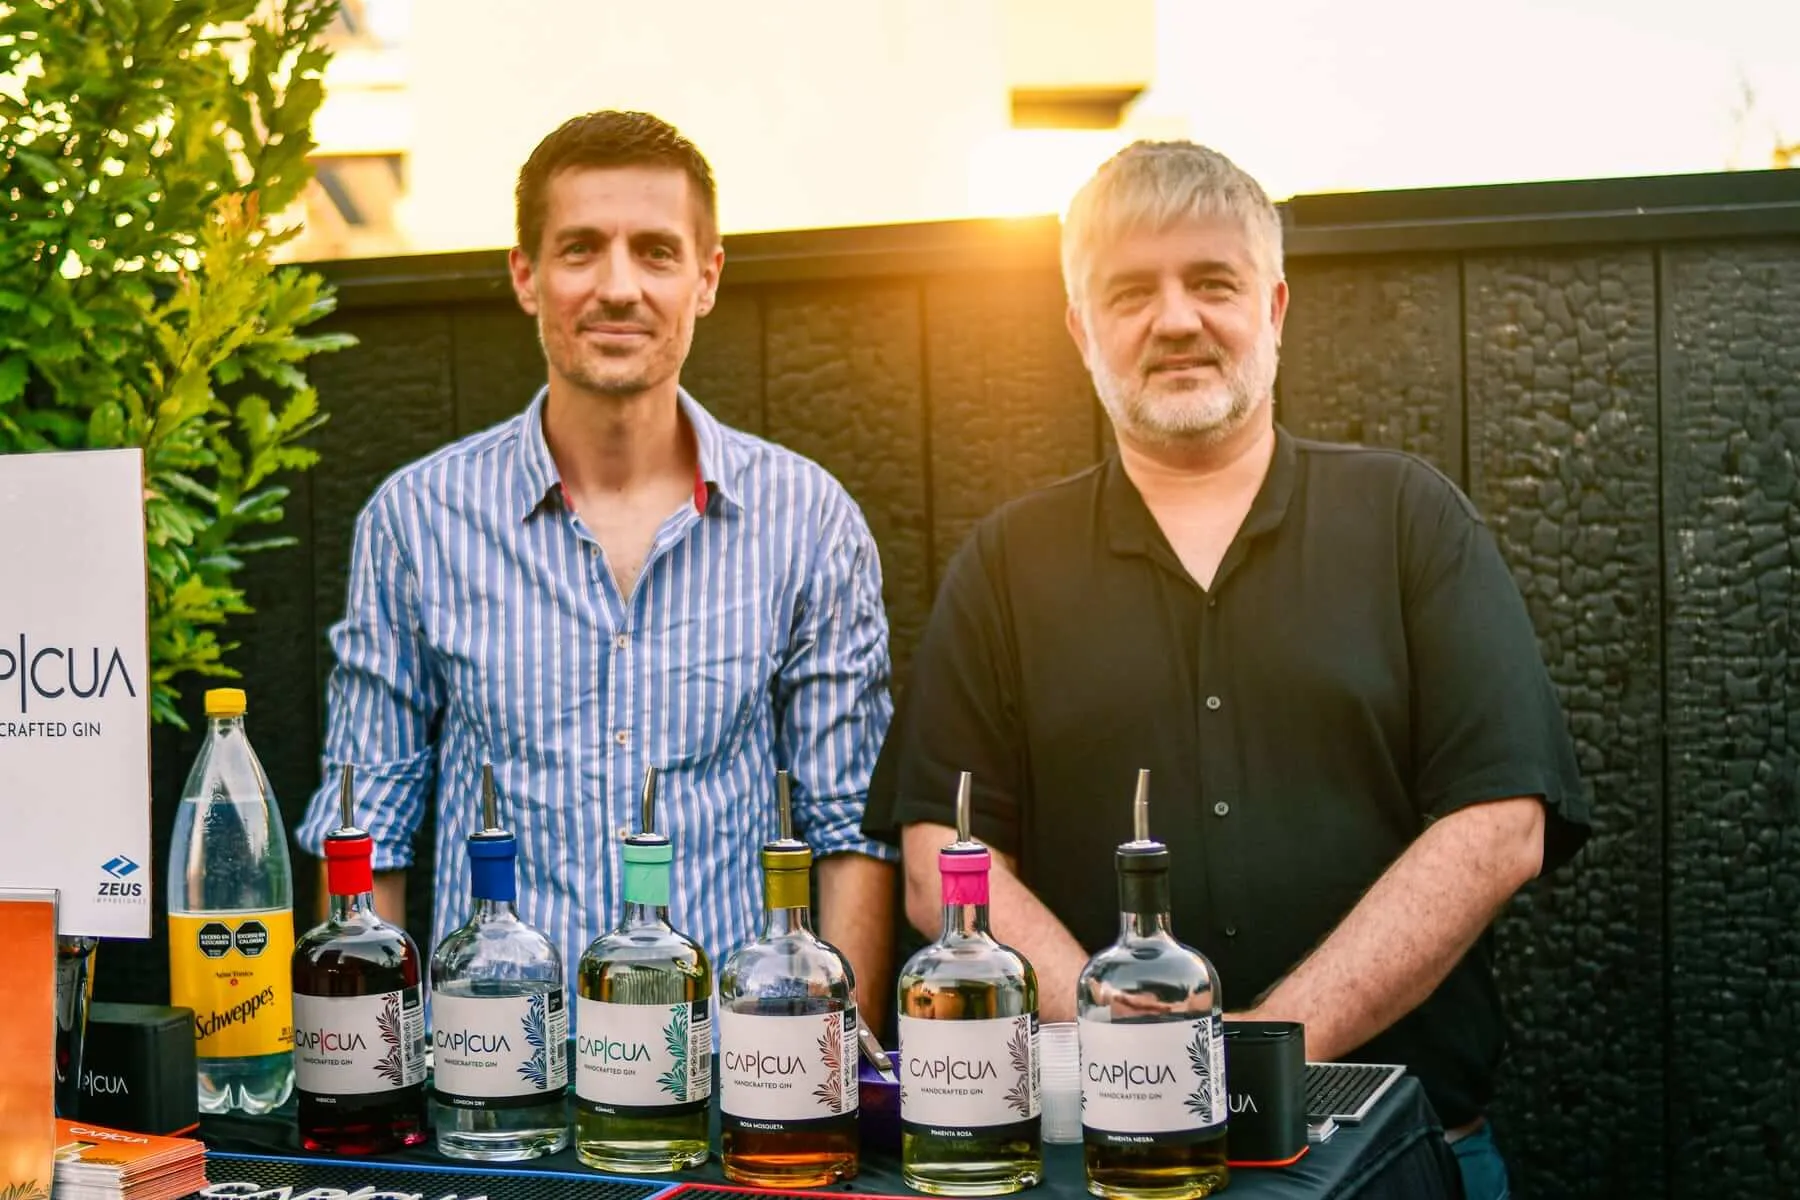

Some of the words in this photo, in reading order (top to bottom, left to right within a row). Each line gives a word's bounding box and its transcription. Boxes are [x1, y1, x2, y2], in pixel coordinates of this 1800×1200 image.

[72, 722, 101, 737] GIN
[98, 882, 142, 897] ZEUS
[194, 985, 274, 1041] Schweppes
[484, 1060, 498, 1068] GIN
[734, 1079, 778, 1089] HANDCRAFTED
[920, 1087, 968, 1096] HANDCRAFTED
[970, 1087, 984, 1096] GIN
[1099, 1092, 1146, 1101] HANDCRAFTED
[1148, 1093, 1162, 1101] GIN
[753, 1122, 784, 1130] MOSQUETA
